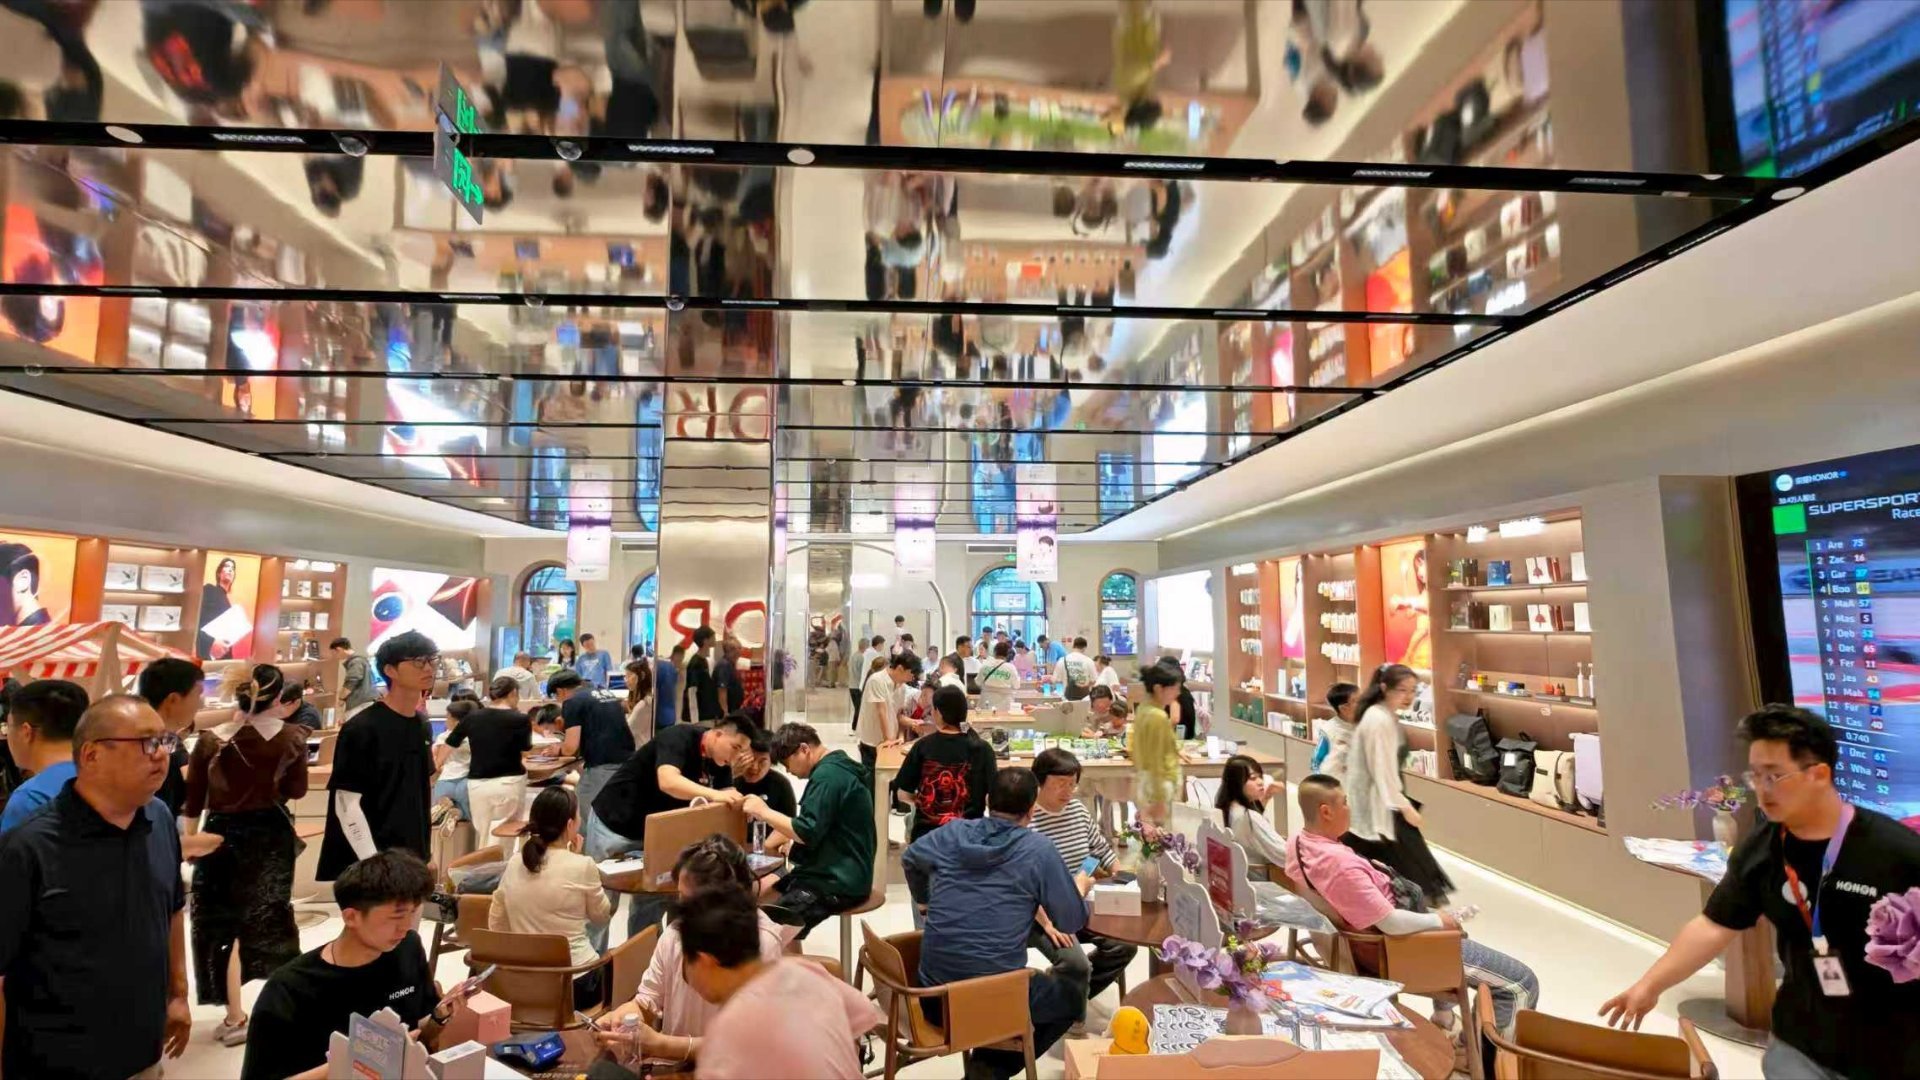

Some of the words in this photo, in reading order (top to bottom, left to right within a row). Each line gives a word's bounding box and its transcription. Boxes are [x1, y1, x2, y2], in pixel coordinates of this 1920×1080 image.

[1808, 492, 1920, 515] SUPERSPOR
[1852, 538, 1864, 547] 75
[1854, 553, 1866, 562] 16
[1859, 600, 1871, 608] 57
[1865, 660, 1876, 668] 11
[1825, 673, 1836, 681] 10
[1826, 687, 1837, 695] 11
[1828, 701, 1839, 709] 12
[1850, 763, 1872, 776] Wha
[1876, 768, 1888, 778] 70
[1876, 785, 1889, 795] 52
[1836, 880, 1877, 897] HONOR
[389, 986, 415, 1000] HONOR
